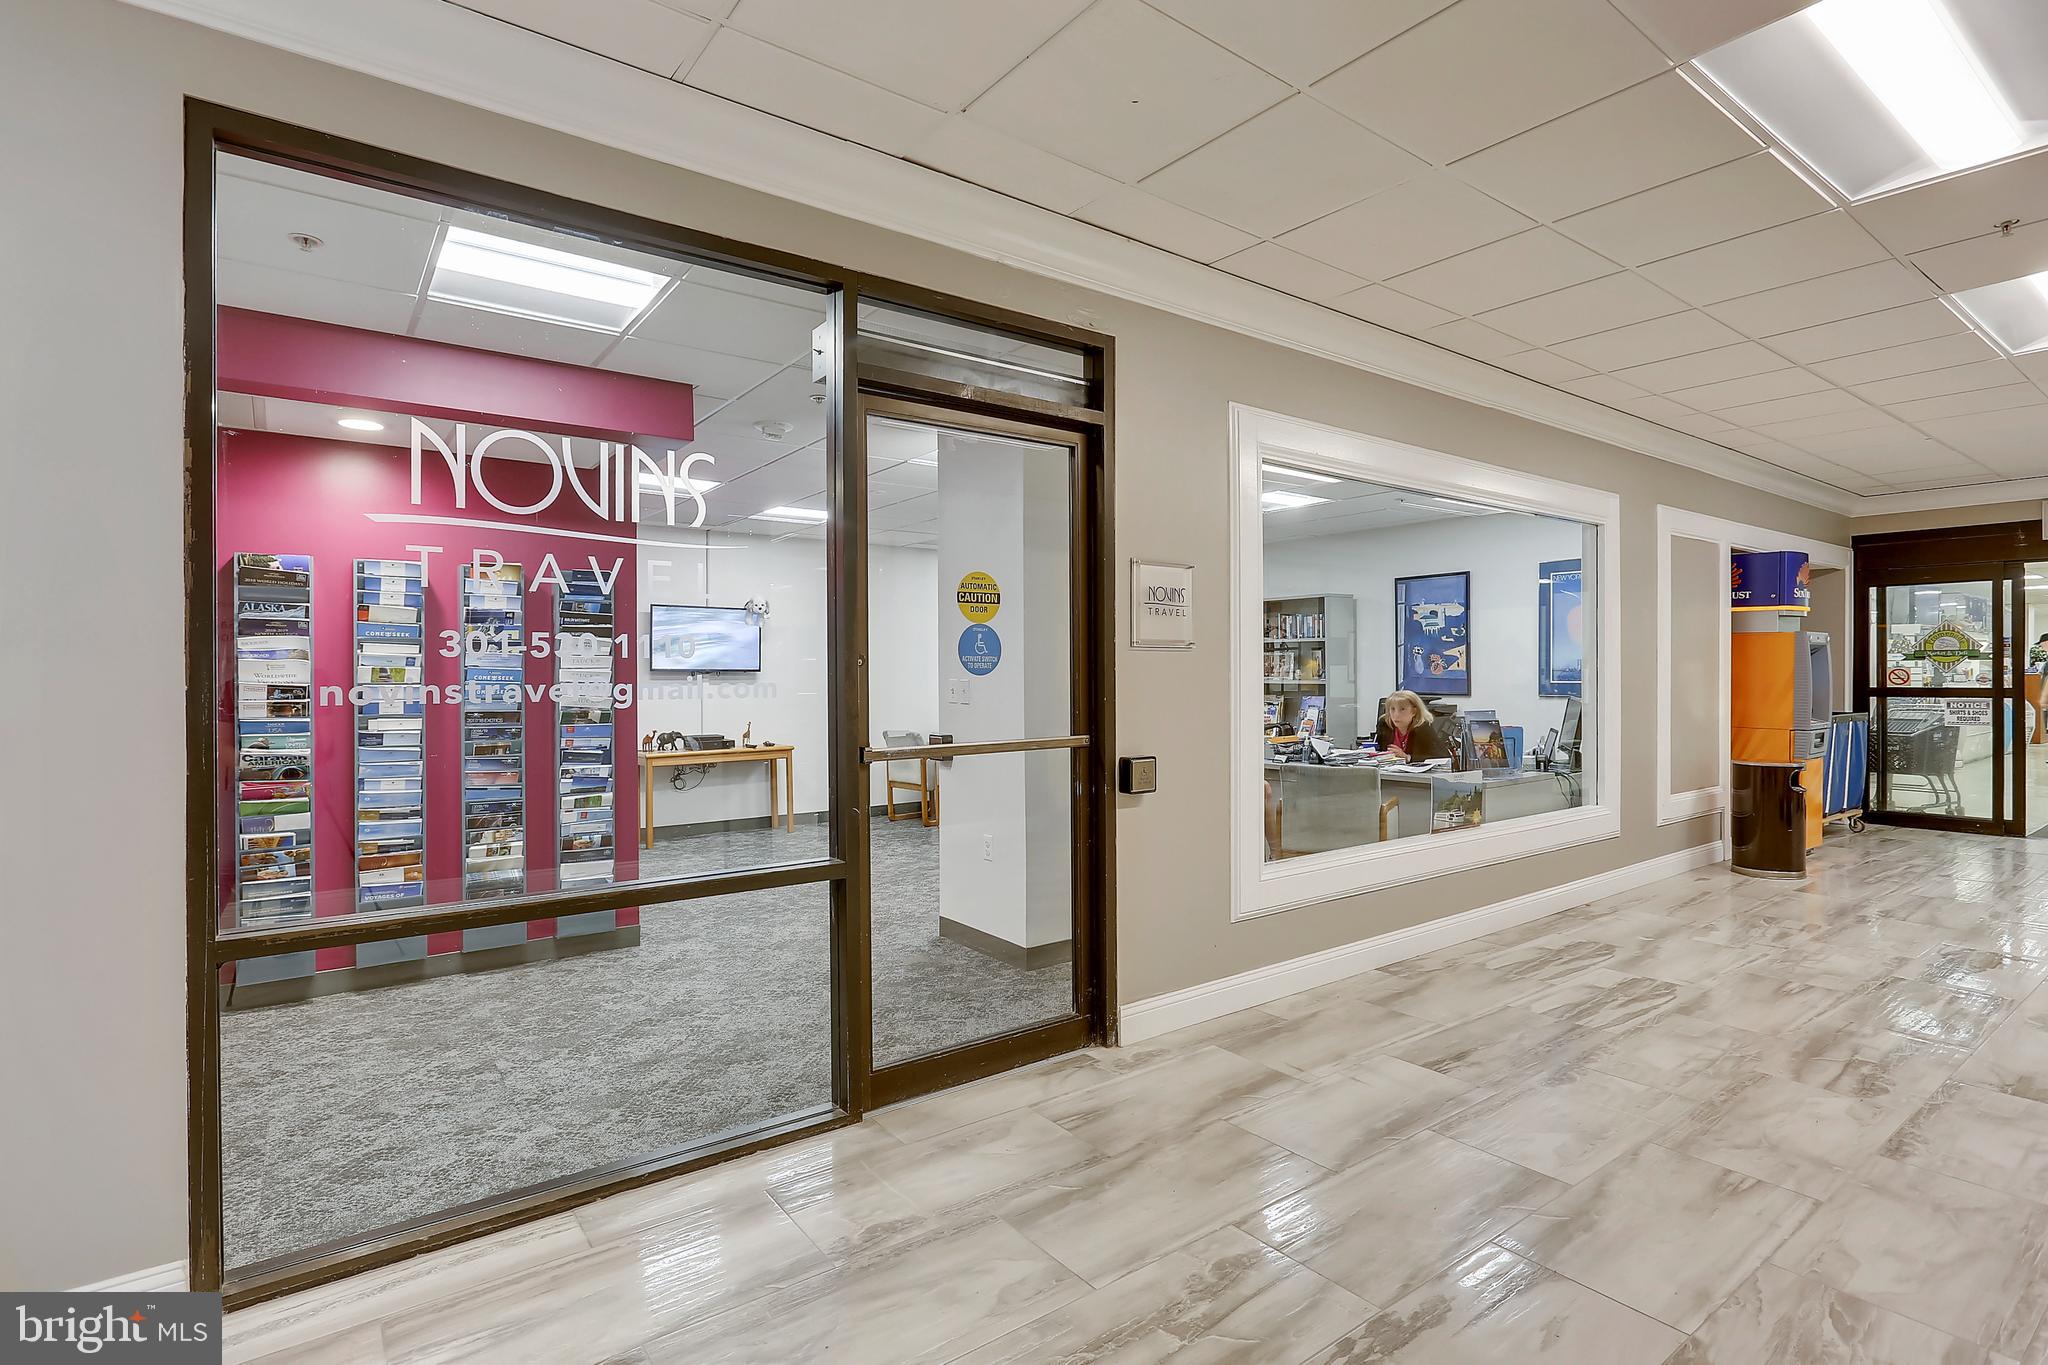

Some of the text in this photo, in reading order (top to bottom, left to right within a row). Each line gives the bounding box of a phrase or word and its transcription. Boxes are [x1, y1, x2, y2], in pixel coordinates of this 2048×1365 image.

[410, 416, 716, 528] NOVINS
[405, 545, 721, 600] TRAVEL
[960, 582, 998, 591] AUTOMATIC
[958, 592, 998, 603] CAUTION
[1148, 586, 1186, 603] NOVINS
[242, 602, 286, 612] ALASKA
[970, 605, 988, 613] DOOR
[1147, 607, 1187, 617] TRAVEL
[319, 678, 777, 709] novinstravegmail.com
[241, 754, 308, 763] Caravan
[364, 893, 395, 901] VOYAGES
